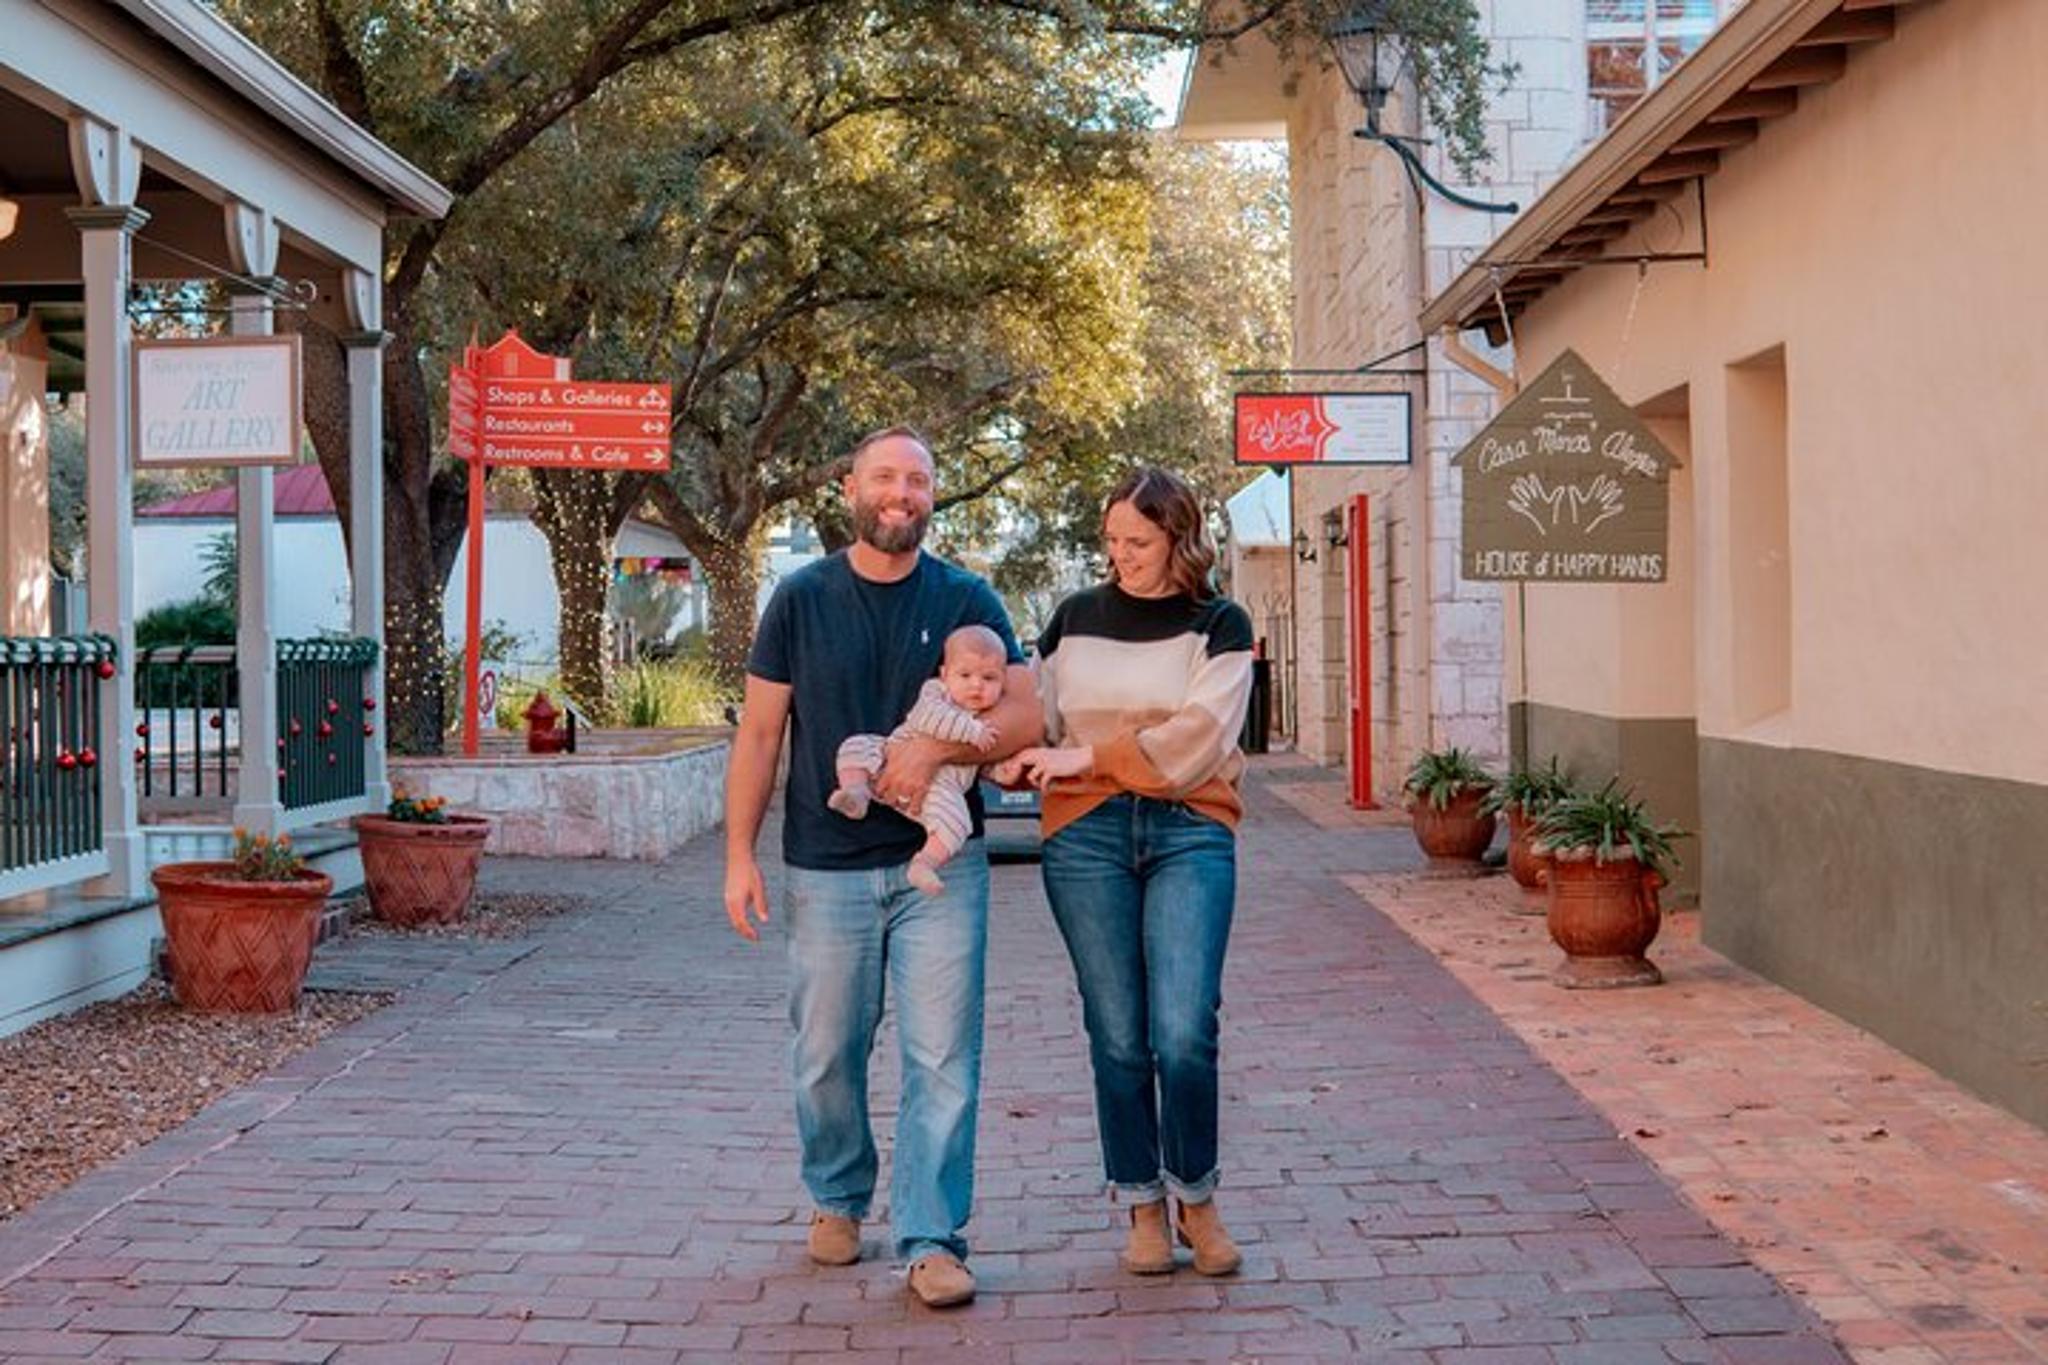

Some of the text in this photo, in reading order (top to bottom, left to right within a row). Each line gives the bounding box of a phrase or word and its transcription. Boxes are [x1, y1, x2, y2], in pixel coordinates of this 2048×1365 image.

[182, 378, 246, 411] ART
[487, 386, 535, 405] Shops
[540, 389, 553, 405] &
[562, 388, 632, 406] Galleries
[146, 417, 279, 450] GALLERY
[485, 415, 574, 433] Restaurants
[484, 443, 564, 461] Restrooms
[570, 444, 583, 460] &
[591, 446, 630, 463] Cafe
[1478, 437, 1529, 473] Casa
[1475, 551, 1529, 576] HOUSE
[1554, 552, 1608, 576] HAPPY
[1610, 553, 1662, 580] HANDS
